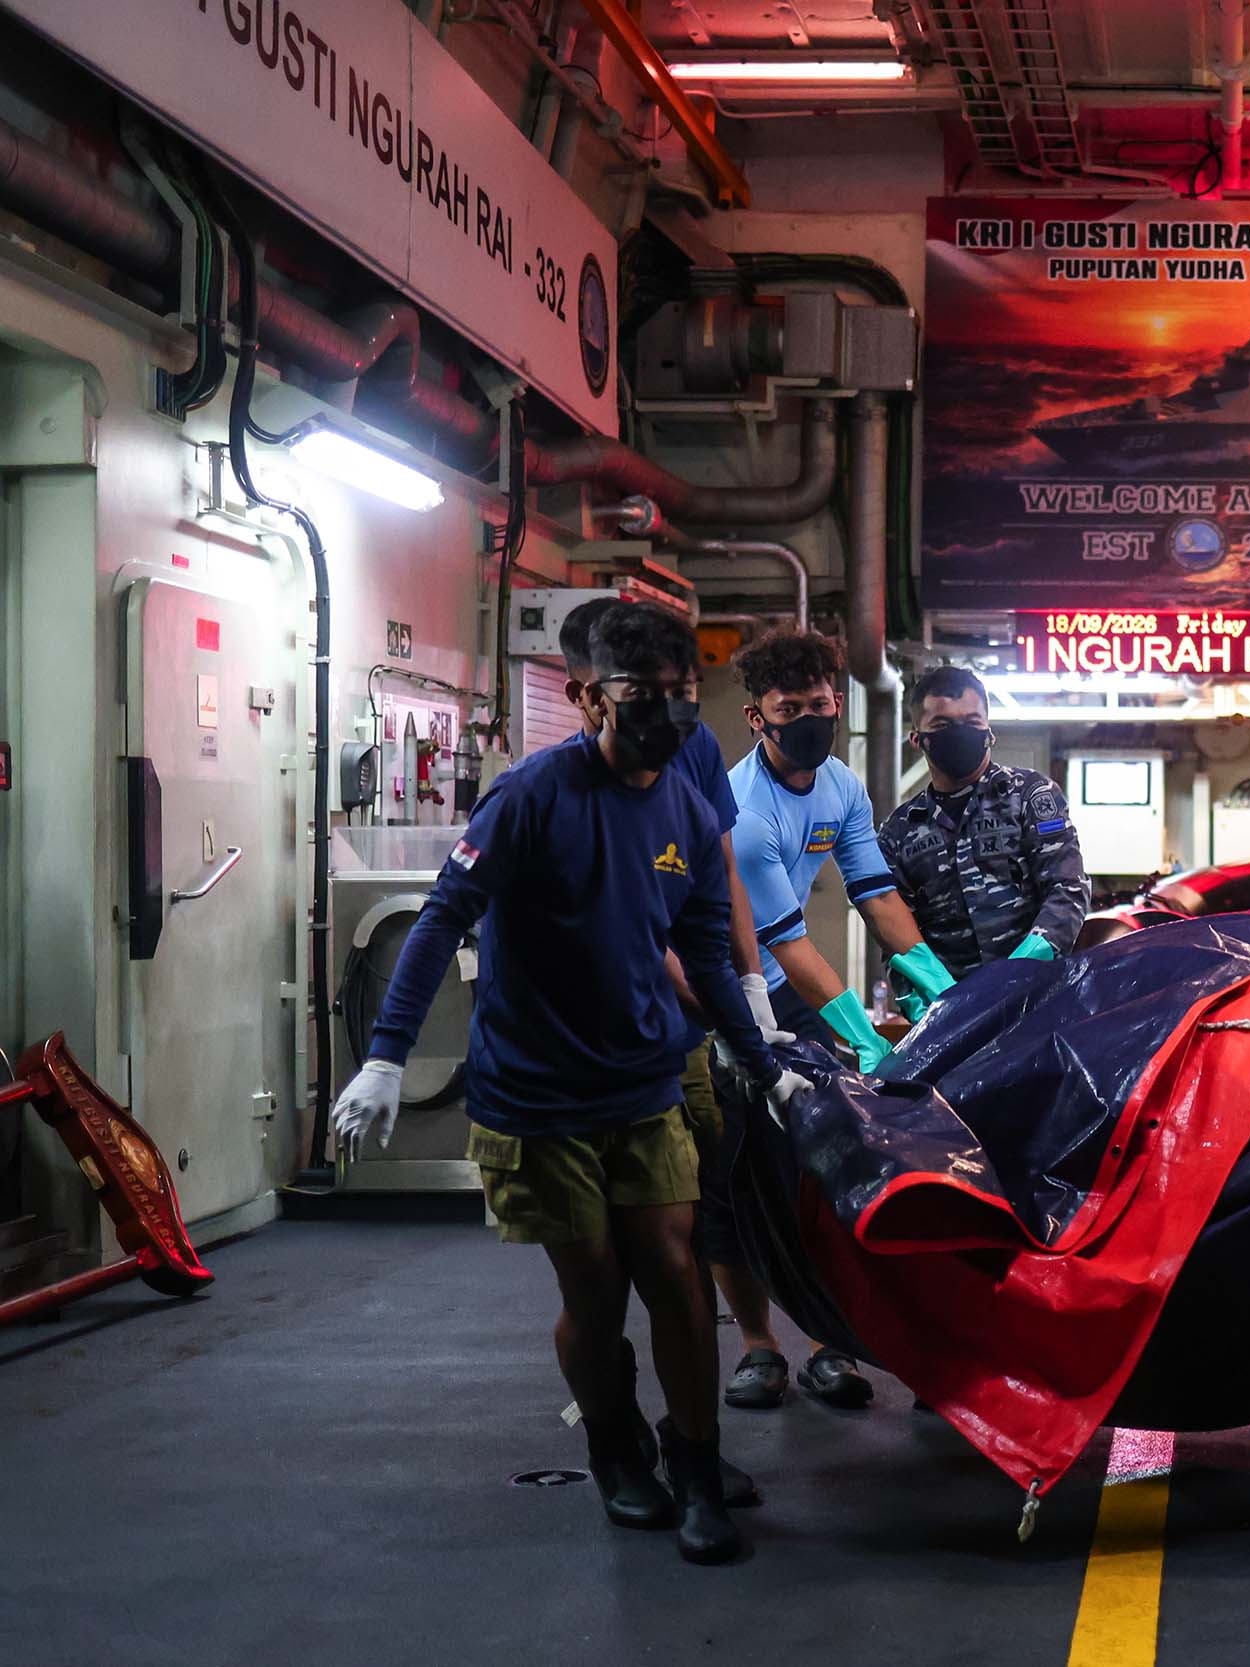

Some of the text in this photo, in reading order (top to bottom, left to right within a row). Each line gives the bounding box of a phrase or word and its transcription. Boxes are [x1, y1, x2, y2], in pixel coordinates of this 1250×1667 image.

[224, 0, 336, 121] GUSTI
[349, 65, 468, 235] NGURAH
[477, 186, 512, 275] RAI
[536, 247, 566, 323] 332
[957, 219, 1012, 249] KRI
[1022, 219, 1035, 249] I
[1044, 220, 1139, 250] GUSTI
[1049, 258, 1158, 280] PUPUTAN
[1165, 259, 1246, 282] YUDHA
[1020, 485, 1216, 514] WELCOME
[1083, 532, 1154, 561] EST
[1046, 613, 1158, 635] 18/09/2026
[1176, 611, 1247, 638] Friday
[1017, 636, 1035, 672] I
[1048, 636, 1231, 672] NGURAH
